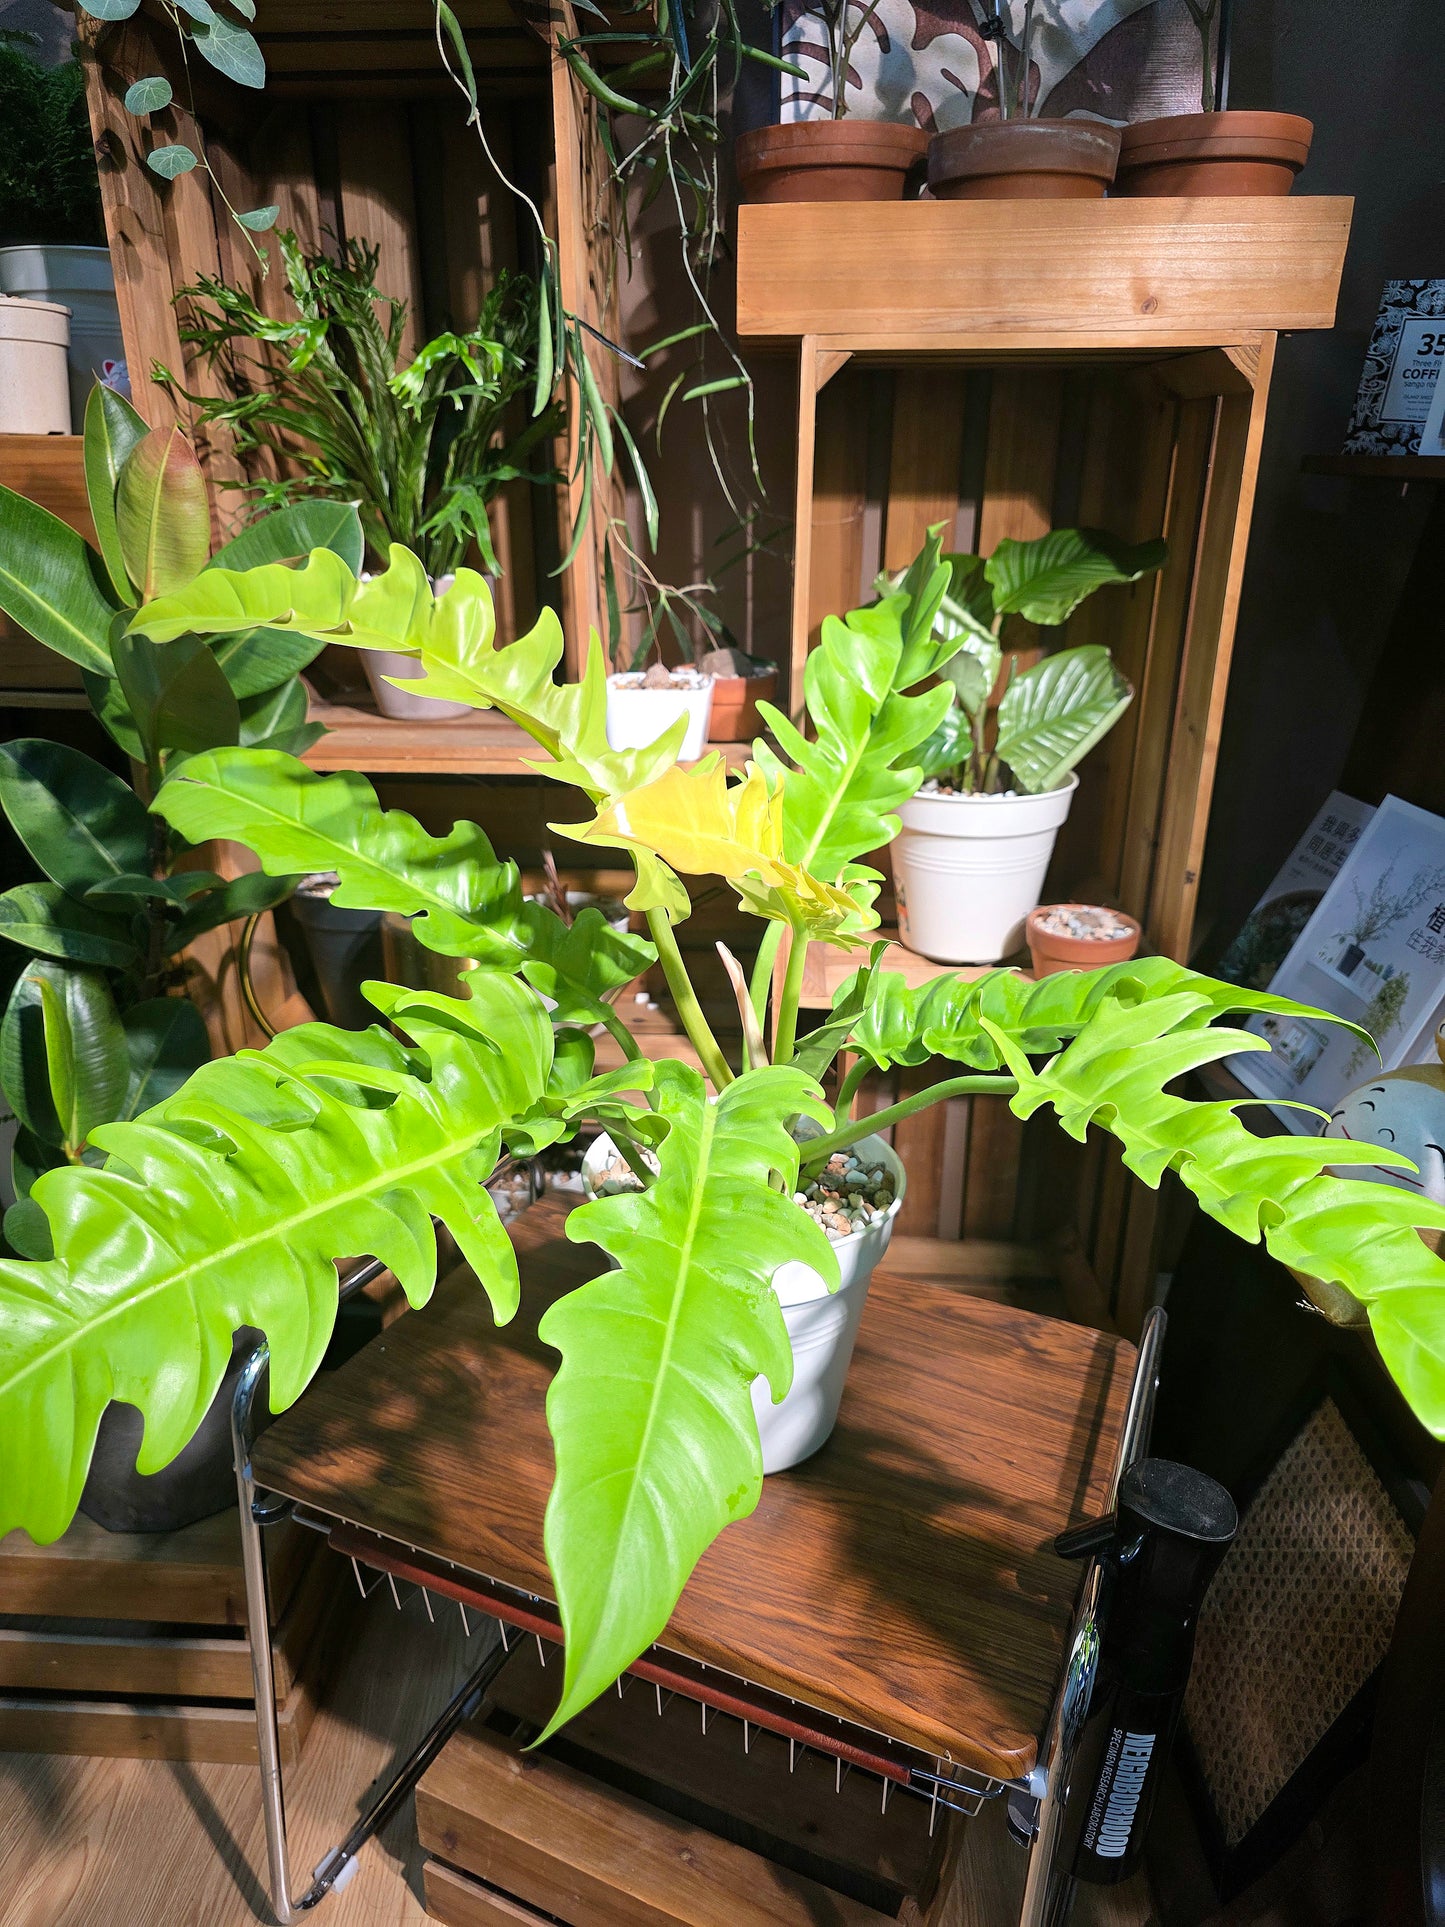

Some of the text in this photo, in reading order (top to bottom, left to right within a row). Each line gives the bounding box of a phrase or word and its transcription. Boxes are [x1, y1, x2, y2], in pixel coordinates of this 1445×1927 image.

[1082, 1727, 1123, 1850] SPECIMEN RESEARCH LABORATORY
[1095, 1731, 1156, 1857] NEIGHBORHOOD
